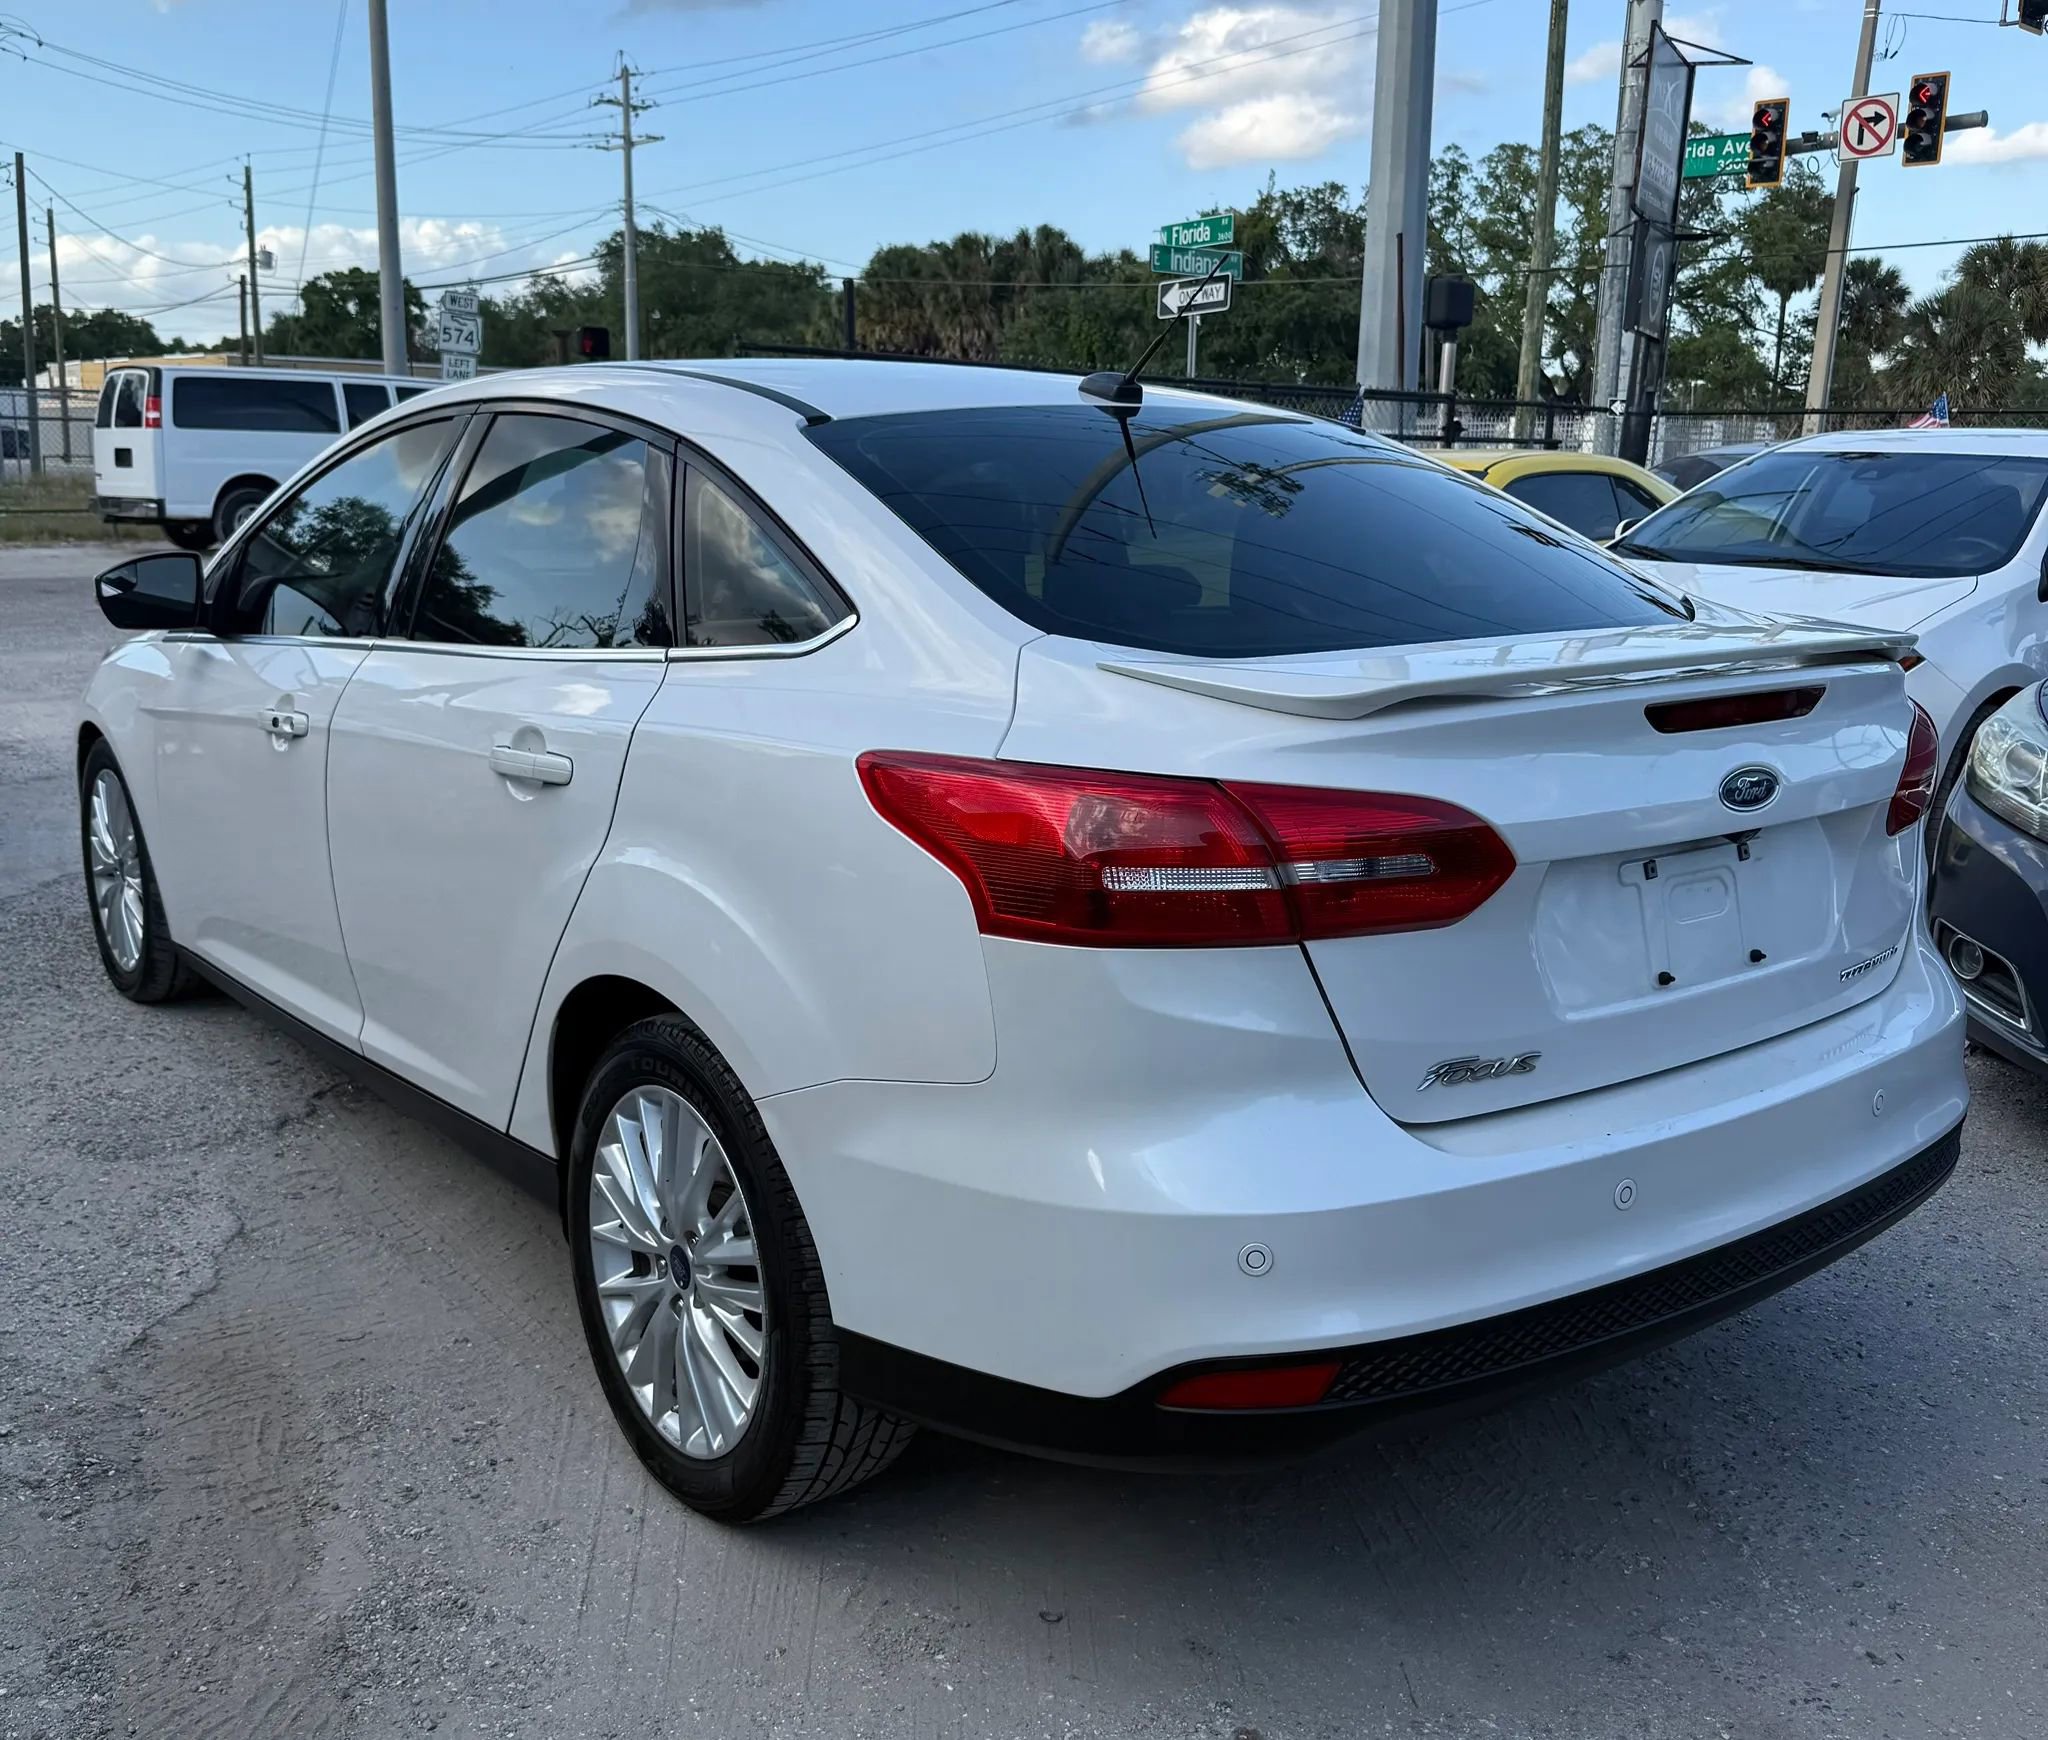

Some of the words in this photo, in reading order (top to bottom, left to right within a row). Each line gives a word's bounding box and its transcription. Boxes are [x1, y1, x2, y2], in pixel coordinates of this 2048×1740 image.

[1685, 142, 1716, 159] rida
[1722, 139, 1751, 155] Ave
[1162, 231, 1167, 246] N
[1172, 222, 1211, 246] Florida
[1153, 251, 1160, 266] E
[1201, 286, 1222, 301] WAY
[450, 294, 474, 310] WEST
[442, 327, 474, 346] 574
[448, 357, 471, 369] LEFT
[447, 370, 471, 380] LANE
[1735, 776, 1769, 800] Ford
